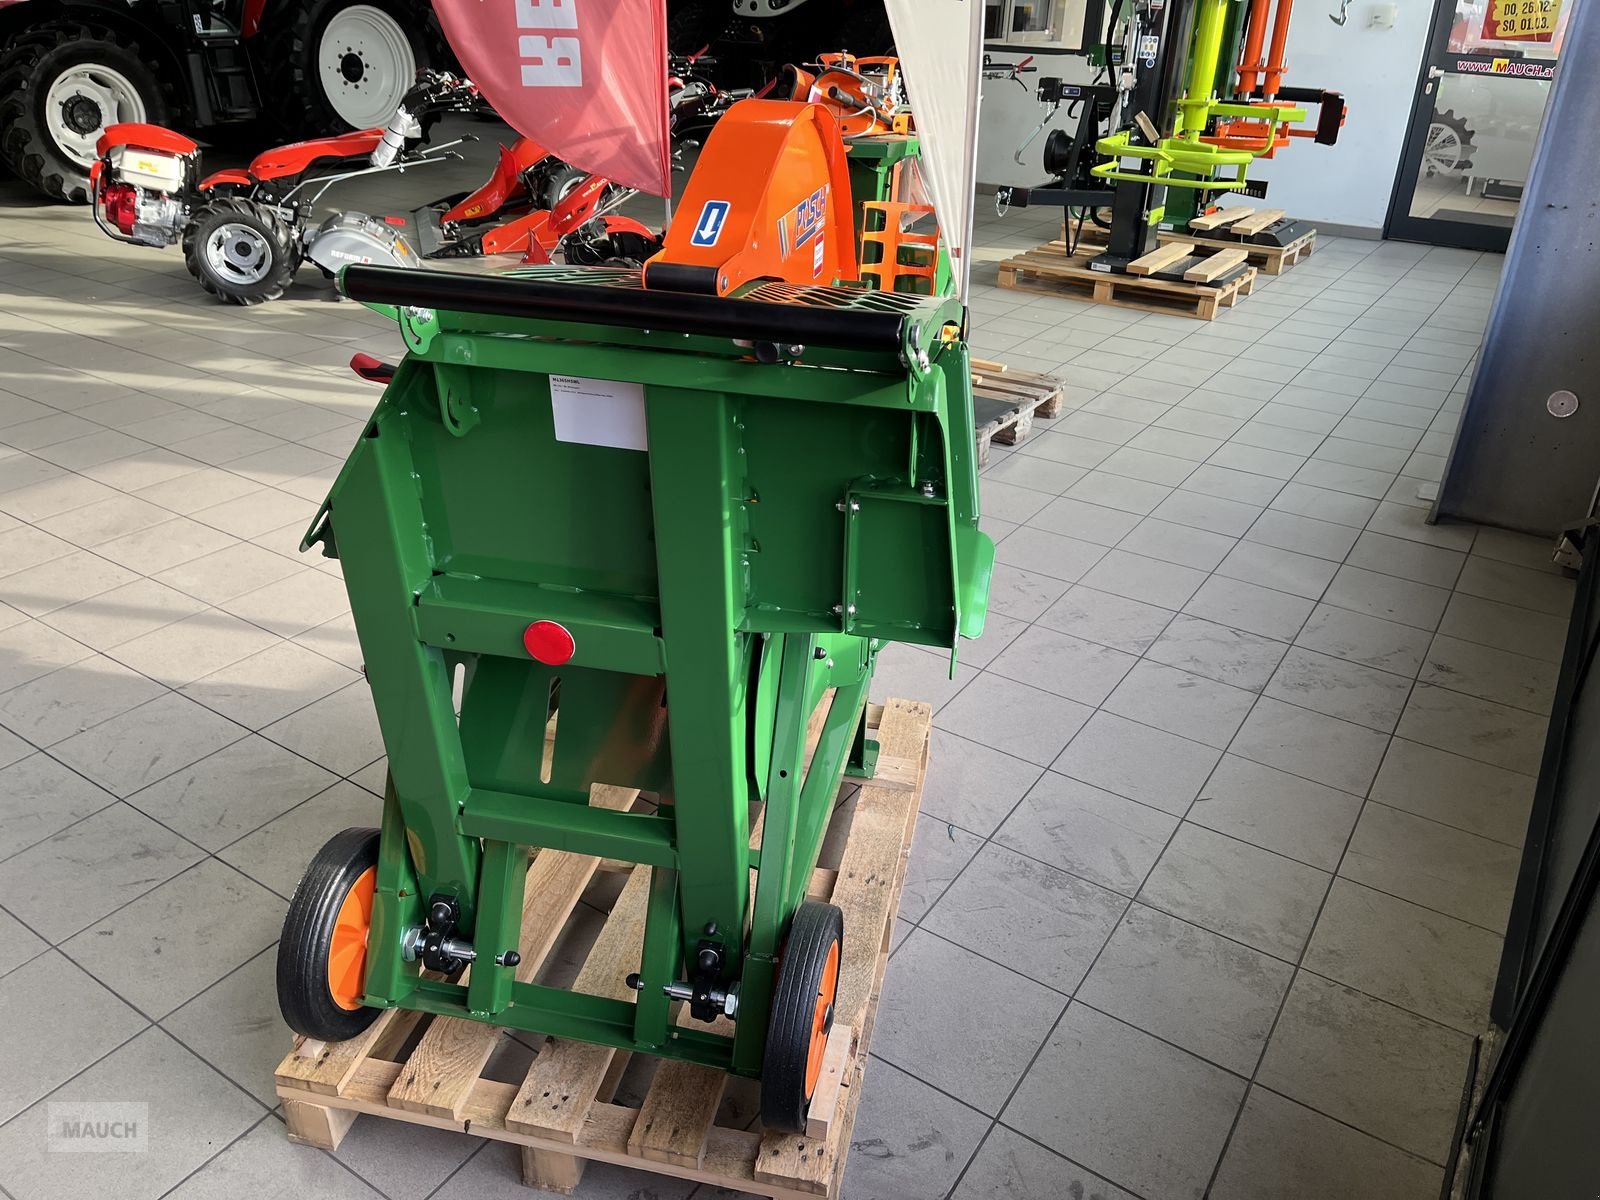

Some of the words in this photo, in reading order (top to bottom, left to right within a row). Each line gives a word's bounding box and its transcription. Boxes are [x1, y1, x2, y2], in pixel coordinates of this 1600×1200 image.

[1503, 3, 1518, 17] DO,
[1502, 19, 1517, 33] SO,
[796, 186, 828, 237] POSCH
